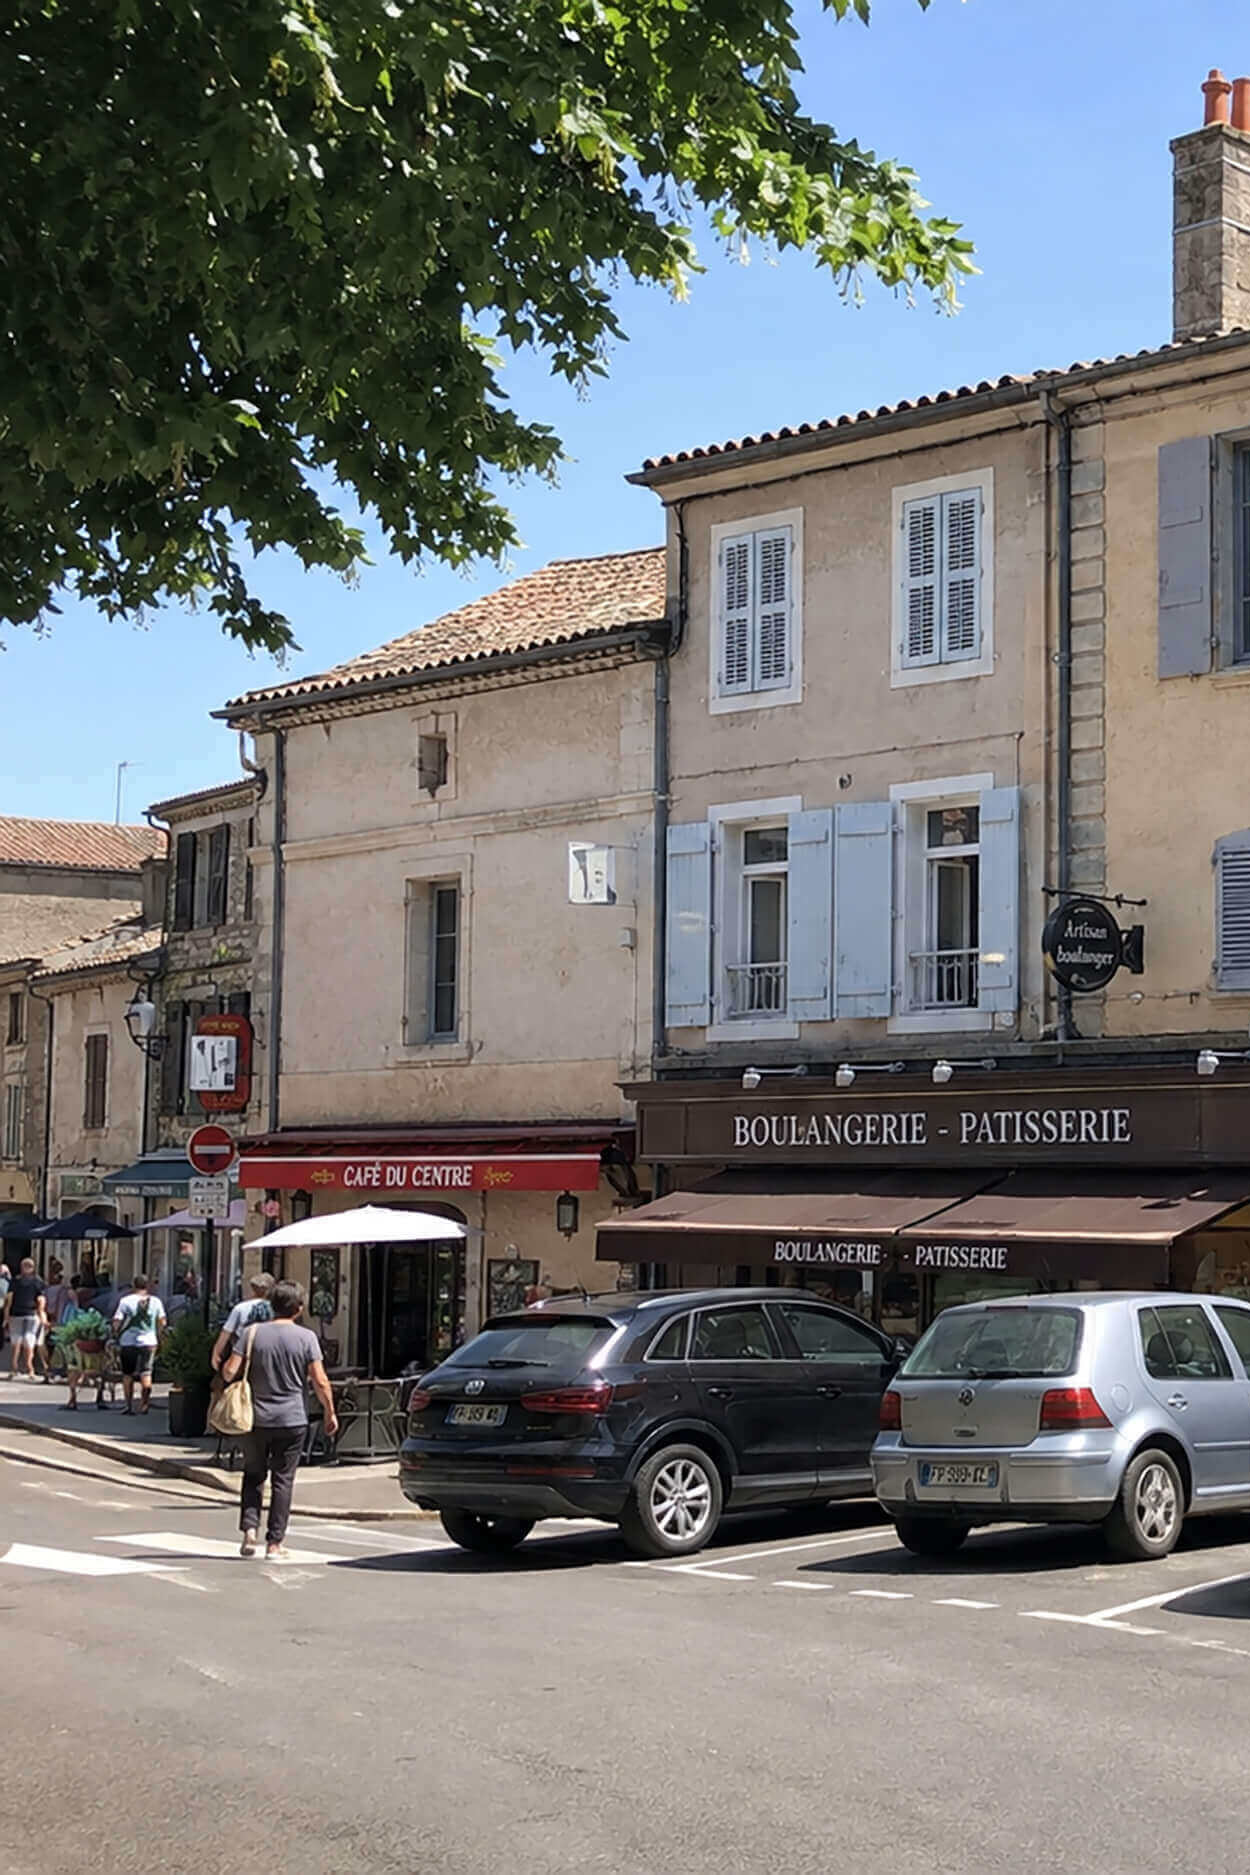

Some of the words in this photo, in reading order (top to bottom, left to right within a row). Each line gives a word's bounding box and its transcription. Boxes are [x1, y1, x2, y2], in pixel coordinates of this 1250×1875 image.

[1064, 919, 1108, 938] Artisan
[733, 1112, 926, 1146] BOULANGERIE
[959, 1109, 1132, 1144] PATISSERIE
[344, 1161, 382, 1186] CAFÉ
[385, 1165, 407, 1186] DU
[411, 1165, 473, 1187] CENTRE
[774, 1241, 881, 1264] BOULANGERIE
[915, 1246, 1008, 1269] PATISSERIE
